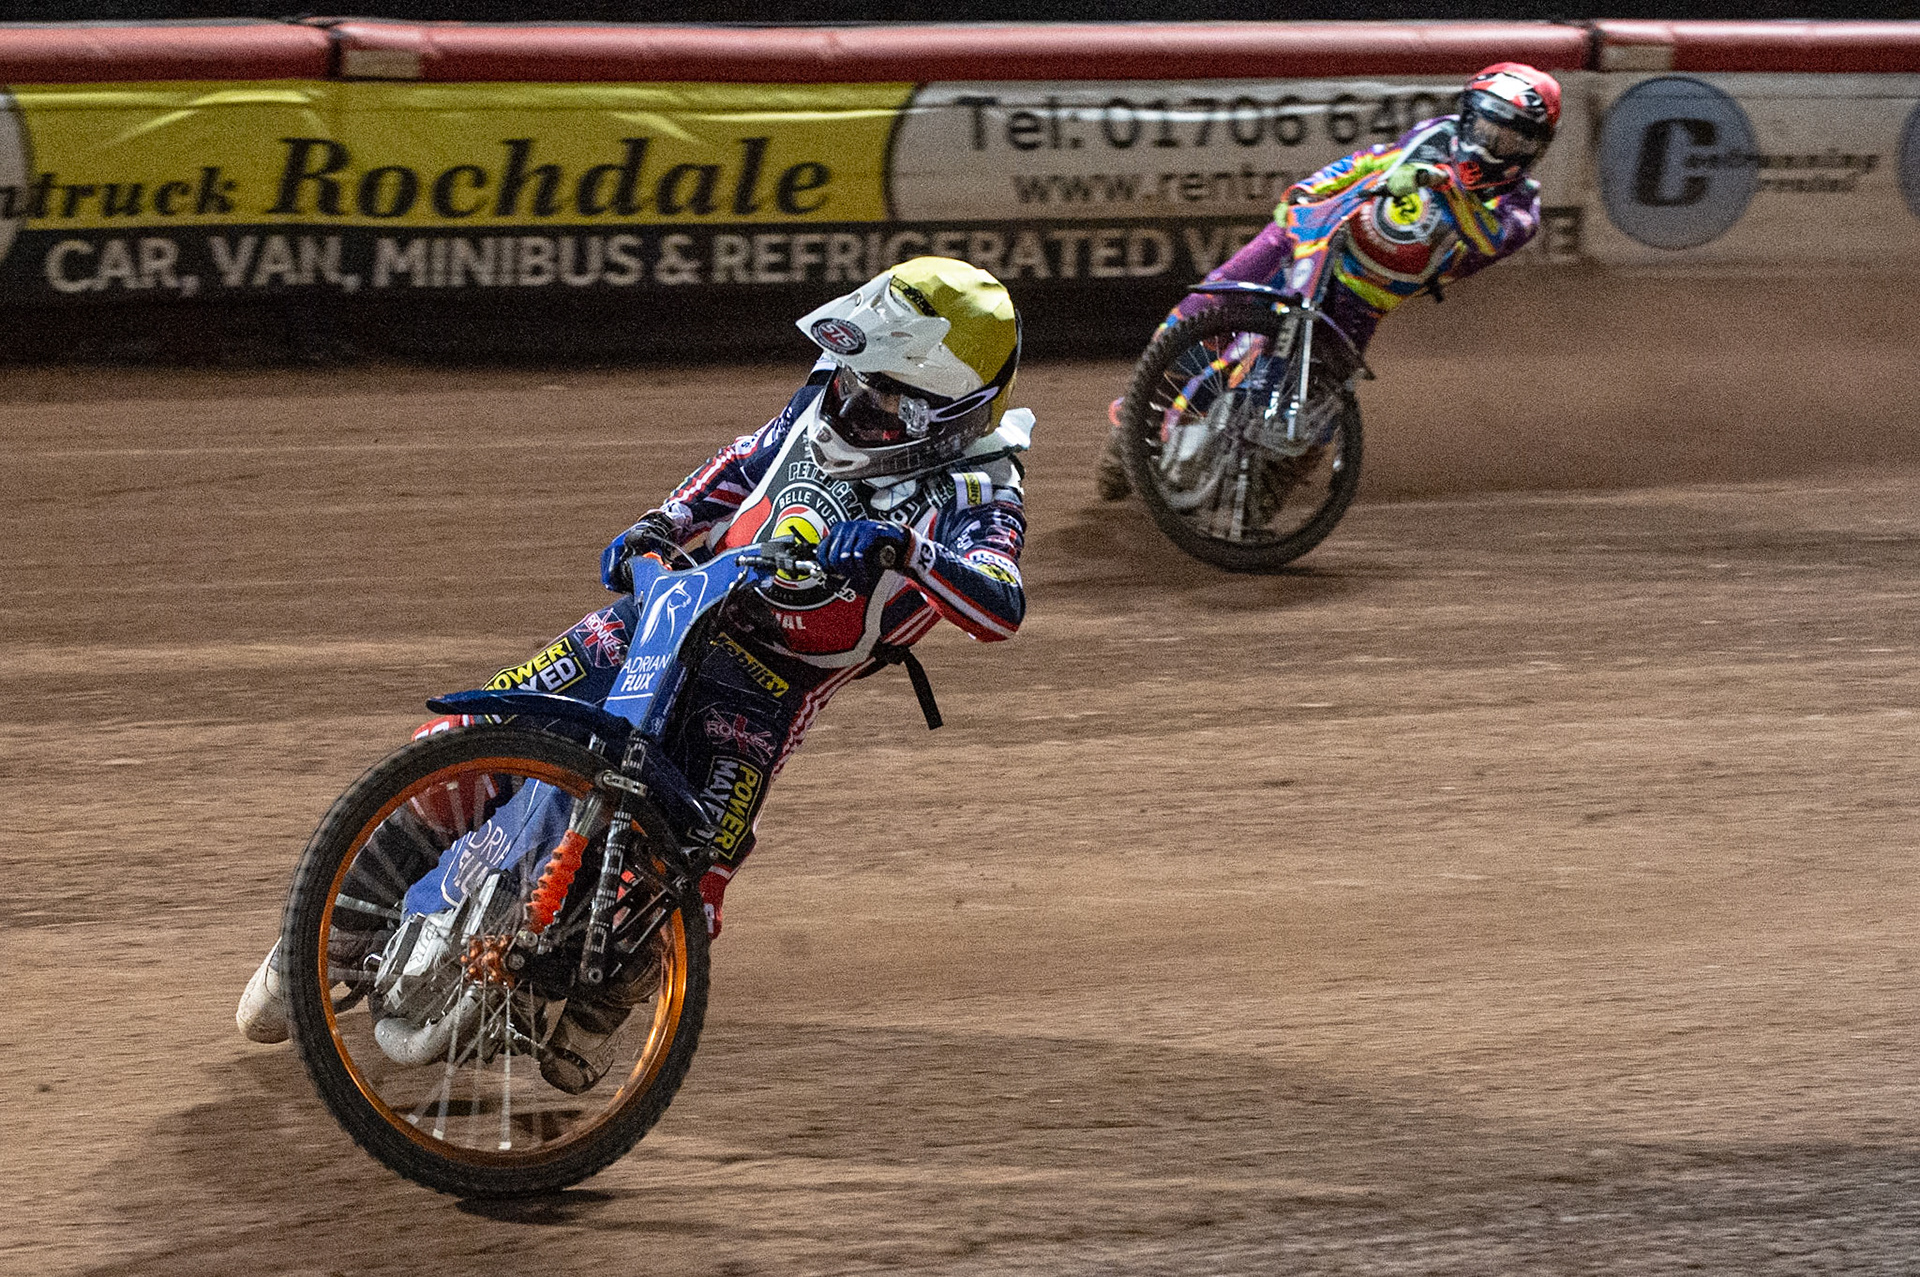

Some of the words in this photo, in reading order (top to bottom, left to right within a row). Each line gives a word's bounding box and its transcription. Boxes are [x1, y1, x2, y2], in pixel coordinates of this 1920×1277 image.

[954, 95, 1084, 149] Tel:
[1102, 96, 1307, 148] 01706
[267, 137, 831, 219] Rochdale
[45, 238, 198, 296] CAR,
[209, 235, 361, 292] VAN,
[373, 233, 642, 288] MINIBUS
[654, 233, 697, 286] &
[713, 229, 1175, 283] REFRIGERATED
[778, 490, 812, 509] BELLE
[815, 497, 838, 526] VUE
[485, 642, 568, 690] OWER
[620, 653, 672, 675] ADRIAN
[620, 672, 655, 692] FLUX
[715, 764, 759, 850] POWER
